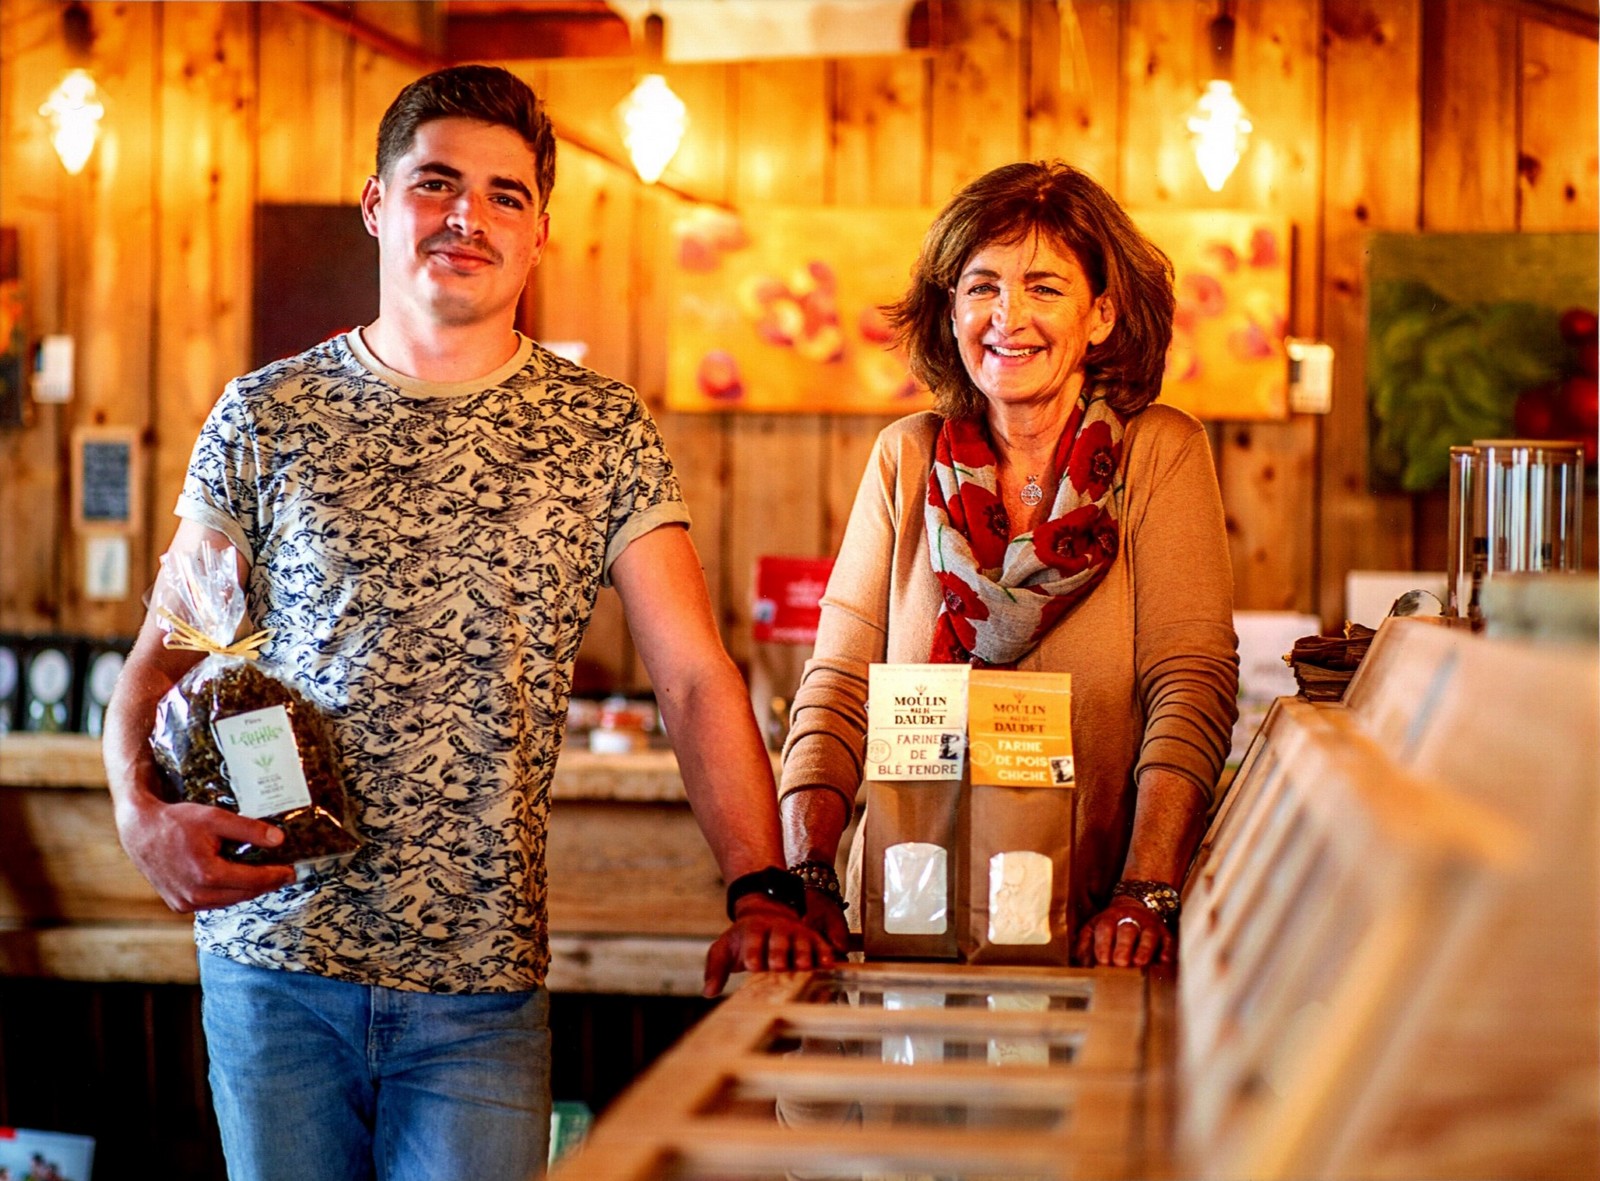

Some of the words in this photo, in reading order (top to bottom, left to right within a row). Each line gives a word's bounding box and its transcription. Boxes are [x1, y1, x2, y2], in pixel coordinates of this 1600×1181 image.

[894, 696, 947, 706] MOULIN
[993, 704, 1046, 714] MOULIN
[895, 715, 946, 724] DAUDET
[994, 723, 1046, 733] DAUDET
[897, 735, 940, 744] FARINE
[997, 740, 1043, 752] FARINE
[910, 750, 927, 760] DE
[995, 755, 1012, 765] DE
[1016, 756, 1048, 767] POIS
[878, 762, 902, 775] BLÉ
[907, 764, 958, 775] TENDRE
[997, 770, 1048, 782] CHICHE
